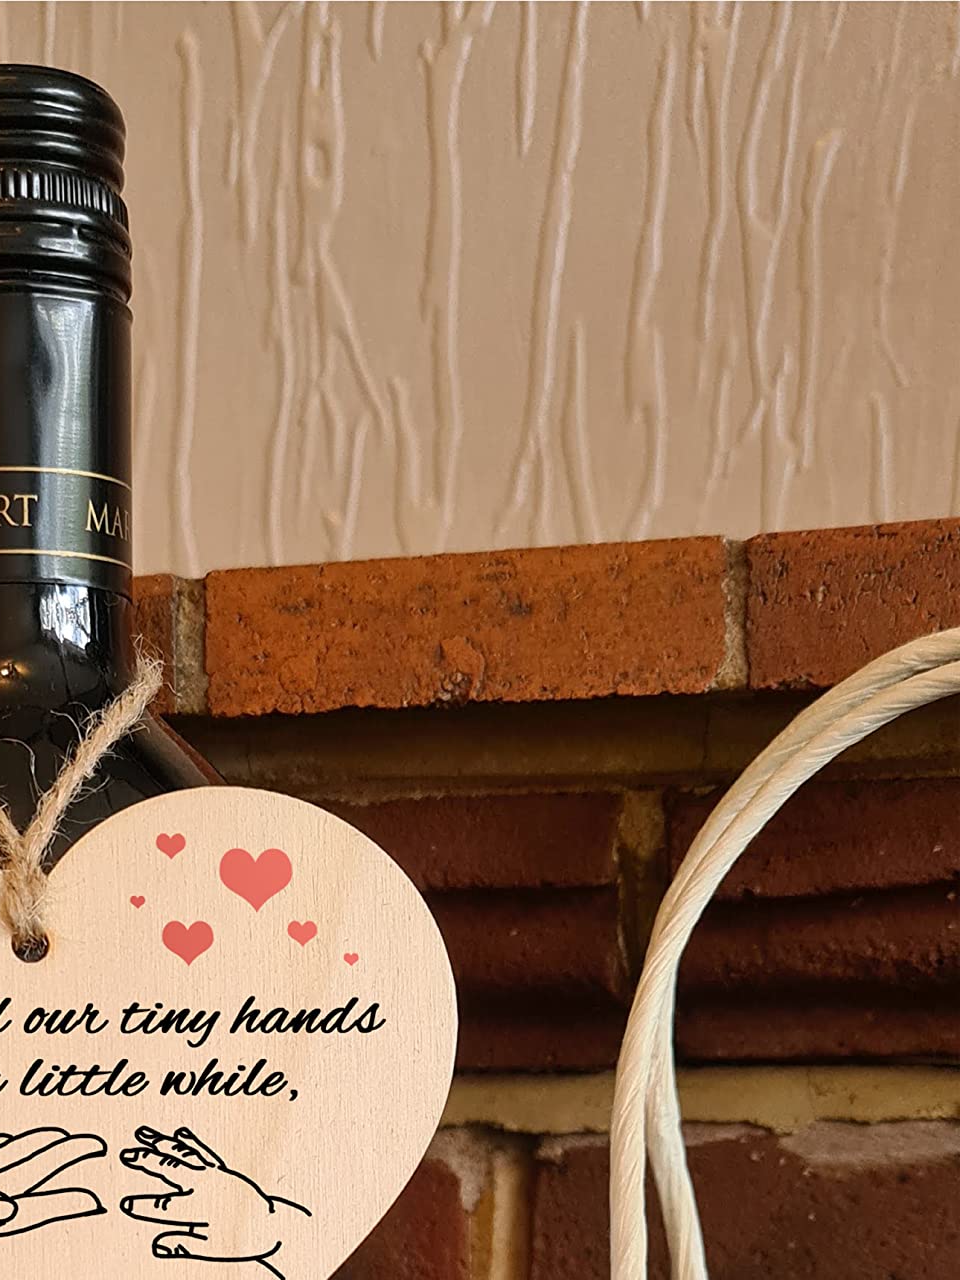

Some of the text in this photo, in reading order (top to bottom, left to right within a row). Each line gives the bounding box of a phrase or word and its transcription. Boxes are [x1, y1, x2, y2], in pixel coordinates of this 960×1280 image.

[23, 1002, 110, 1035] our
[120, 1001, 221, 1049] tiny
[229, 995, 387, 1034] hands
[19, 1058, 150, 1097] little
[159, 1058, 298, 1102] while,
